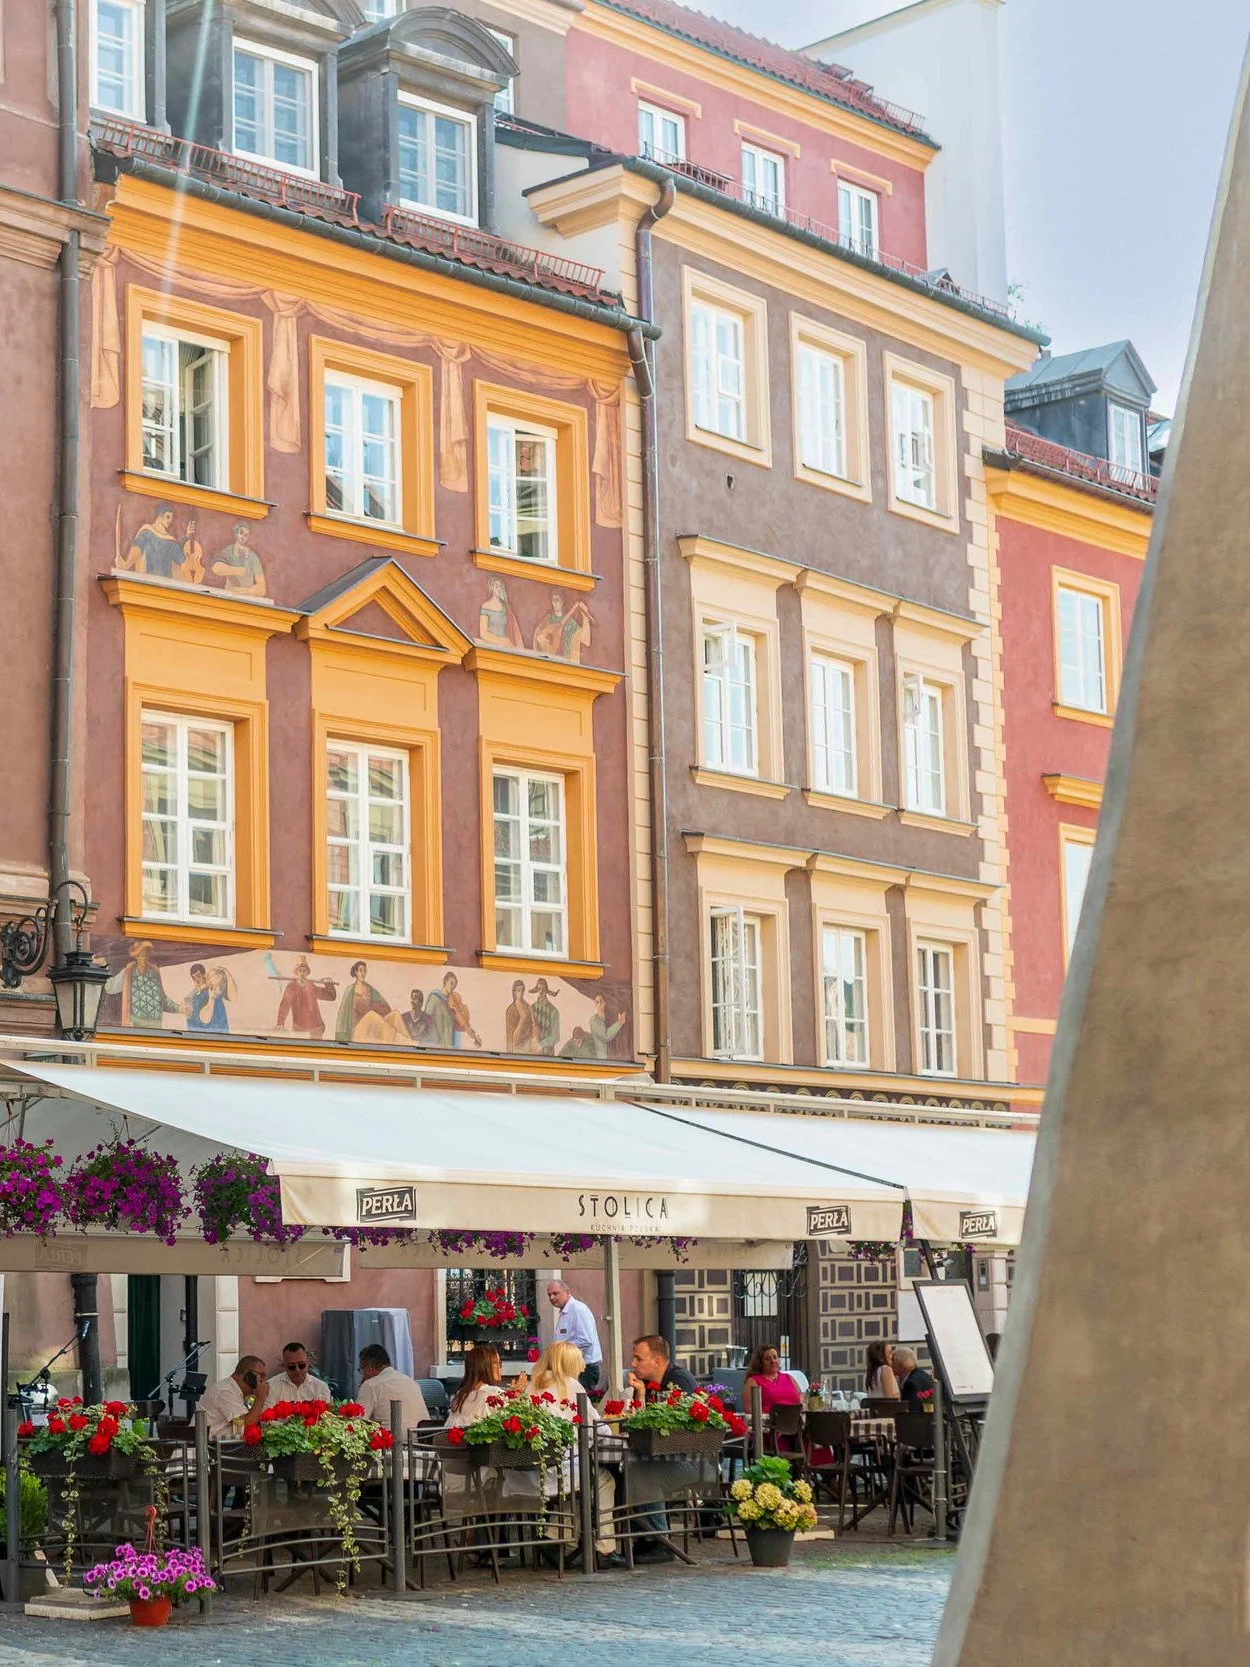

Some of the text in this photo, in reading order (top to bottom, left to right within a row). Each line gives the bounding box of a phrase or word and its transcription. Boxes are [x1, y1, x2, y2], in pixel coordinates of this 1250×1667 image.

[361, 1193, 413, 1216] PERŁA
[578, 1194, 668, 1219] STOLICA
[590, 1224, 625, 1232] KUCHNIA
[810, 1211, 849, 1230] PERŁA
[962, 1216, 996, 1233] PERŁA
